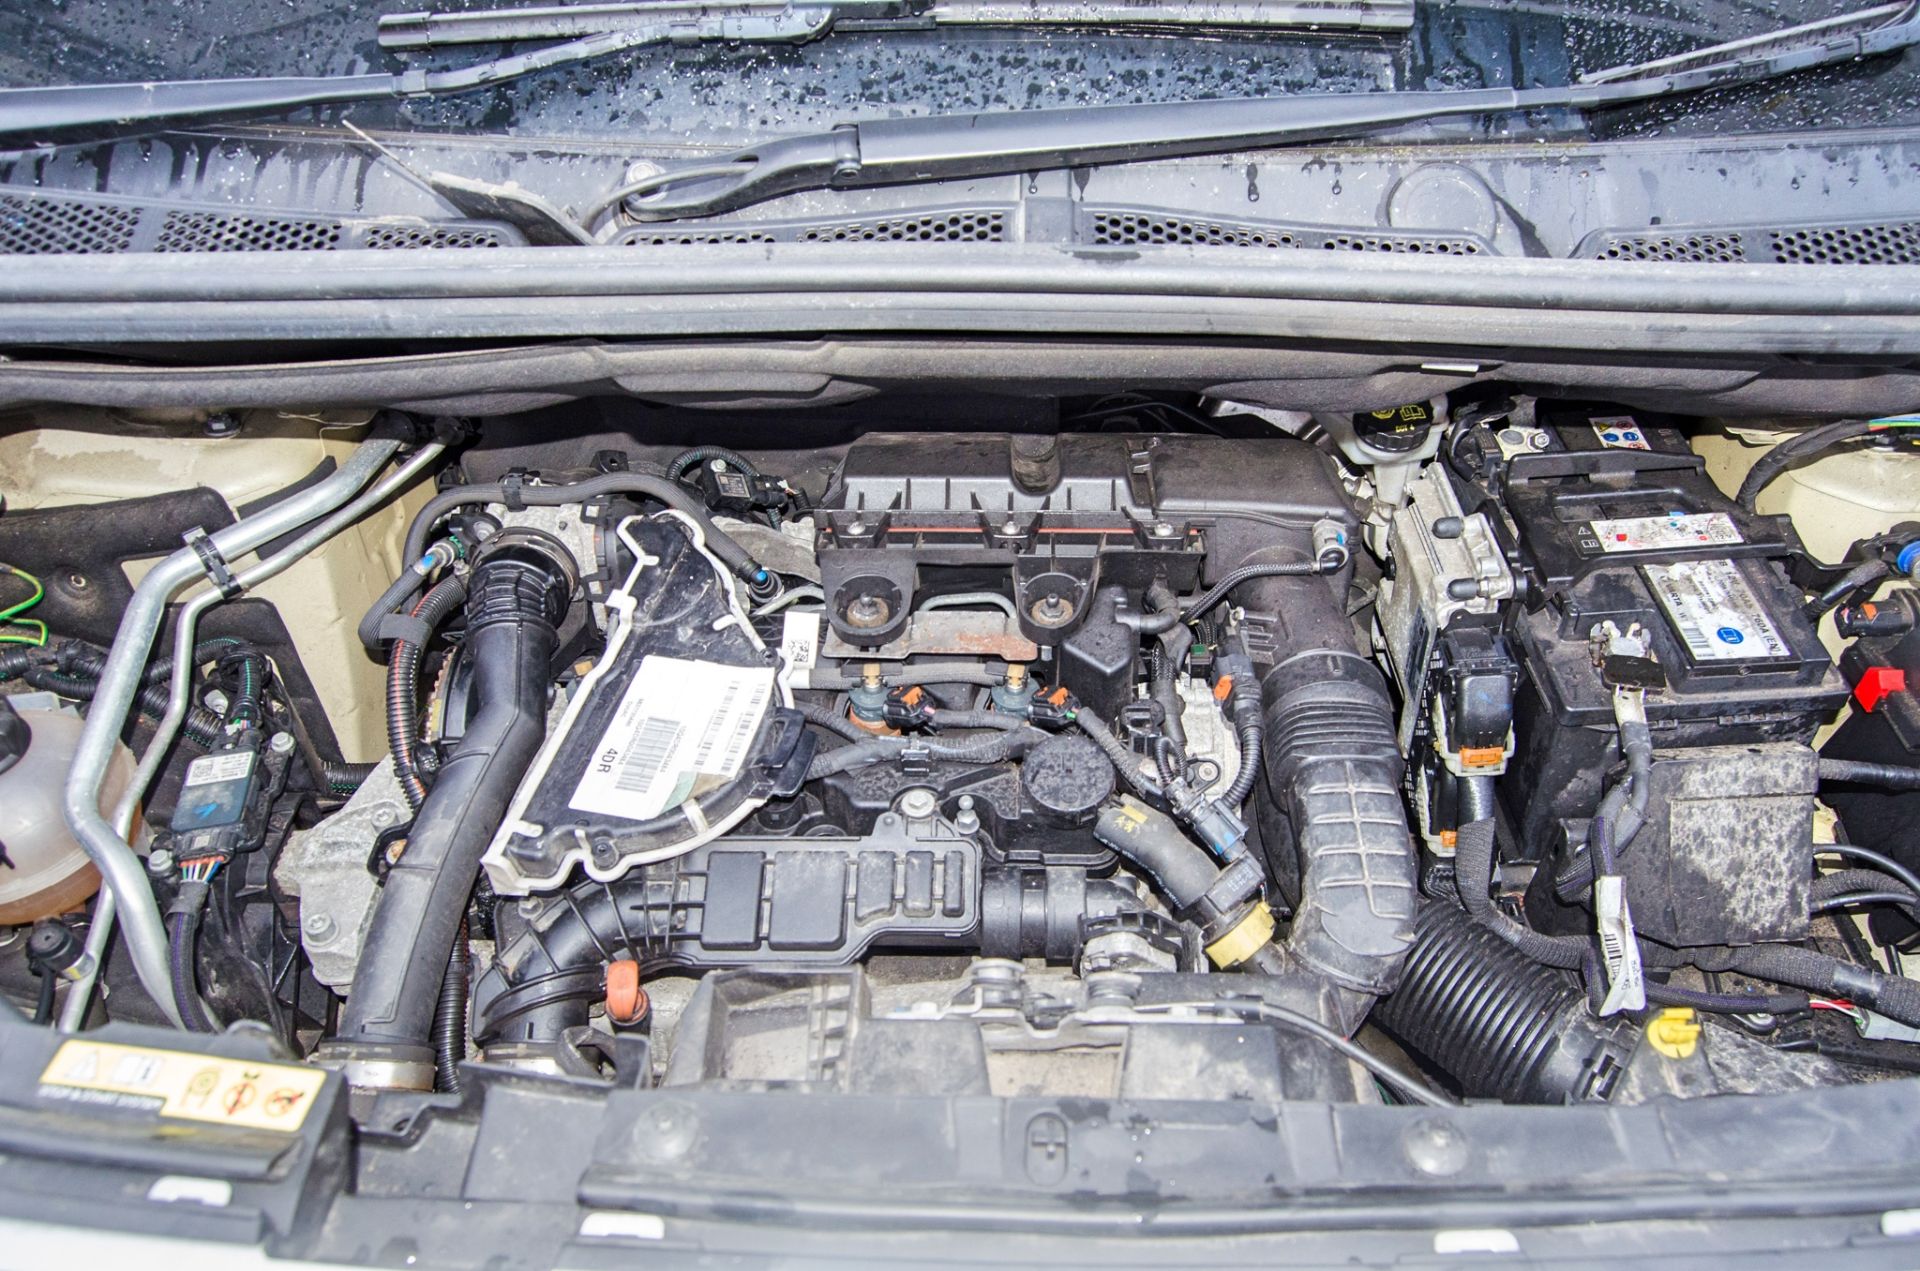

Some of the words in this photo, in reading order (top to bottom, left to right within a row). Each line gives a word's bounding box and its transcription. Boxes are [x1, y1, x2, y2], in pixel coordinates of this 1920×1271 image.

[1752, 613, 1769, 634] 760A
[1763, 635, 1782, 653] (EN)
[597, 748, 619, 775] 4DR
